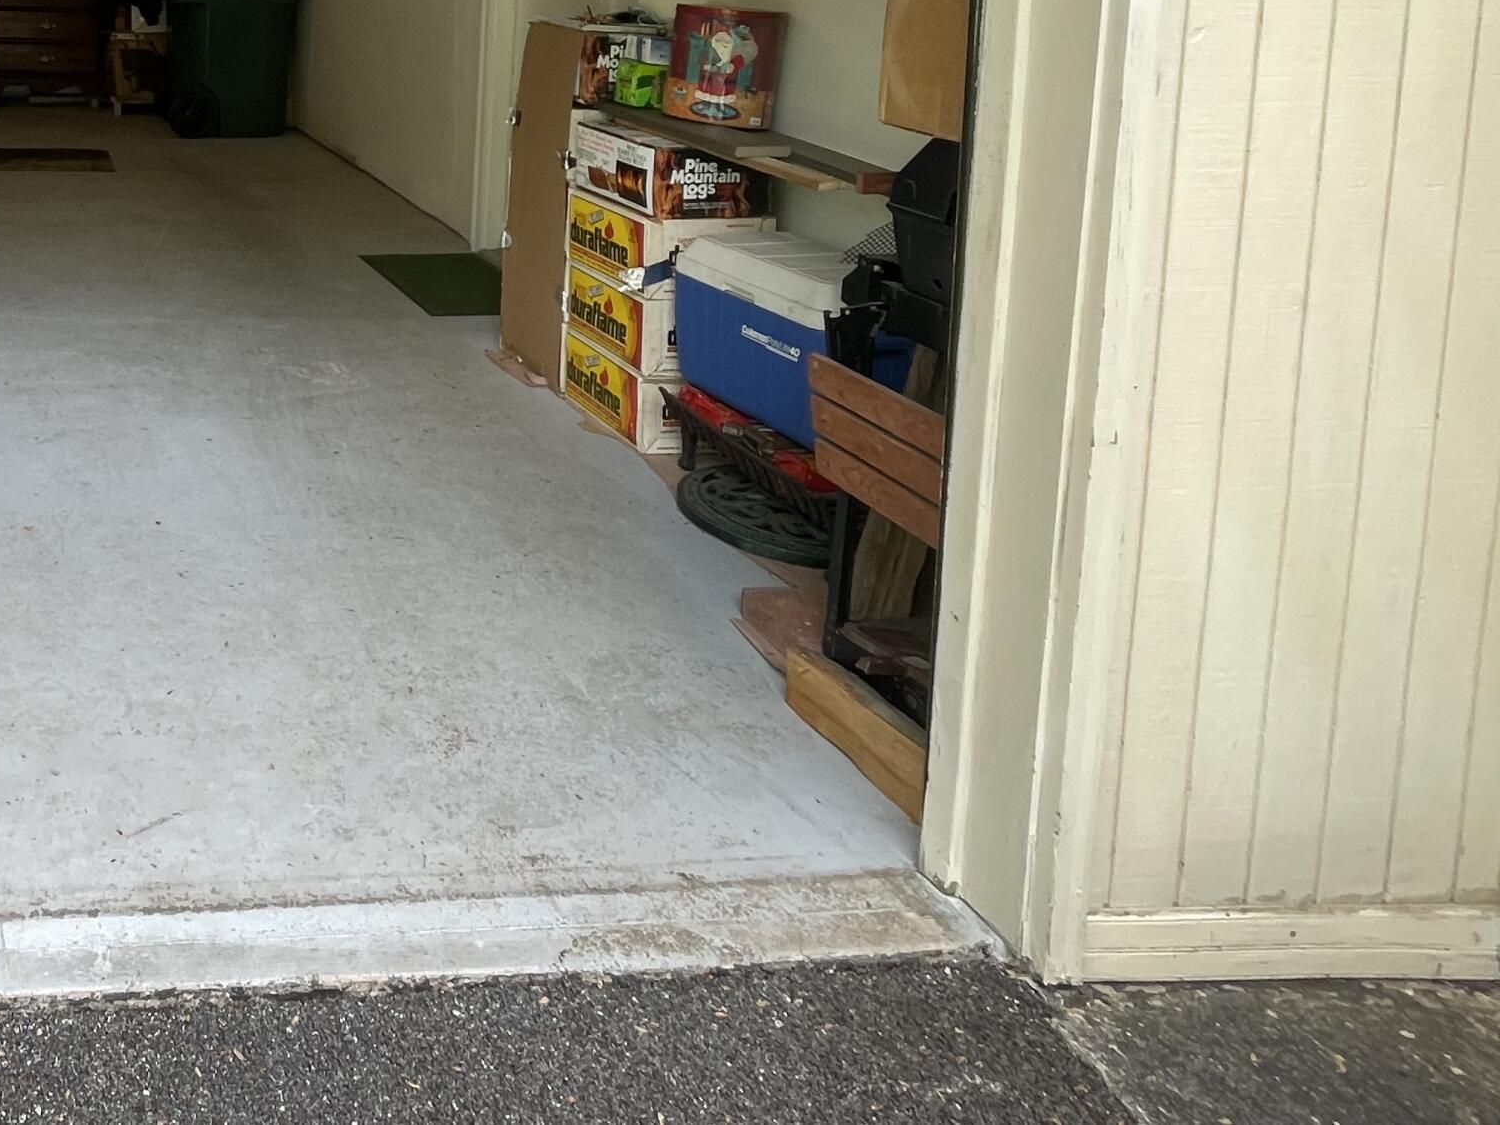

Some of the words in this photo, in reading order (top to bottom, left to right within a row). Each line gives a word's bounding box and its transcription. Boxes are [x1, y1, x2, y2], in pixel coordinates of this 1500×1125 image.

[670, 168, 741, 185] Mountain
[685, 158, 718, 173] Pine
[683, 183, 716, 200] Logs
[570, 217, 628, 268] duraflame
[570, 288, 627, 345] duraflame
[566, 356, 621, 418] duraflame
